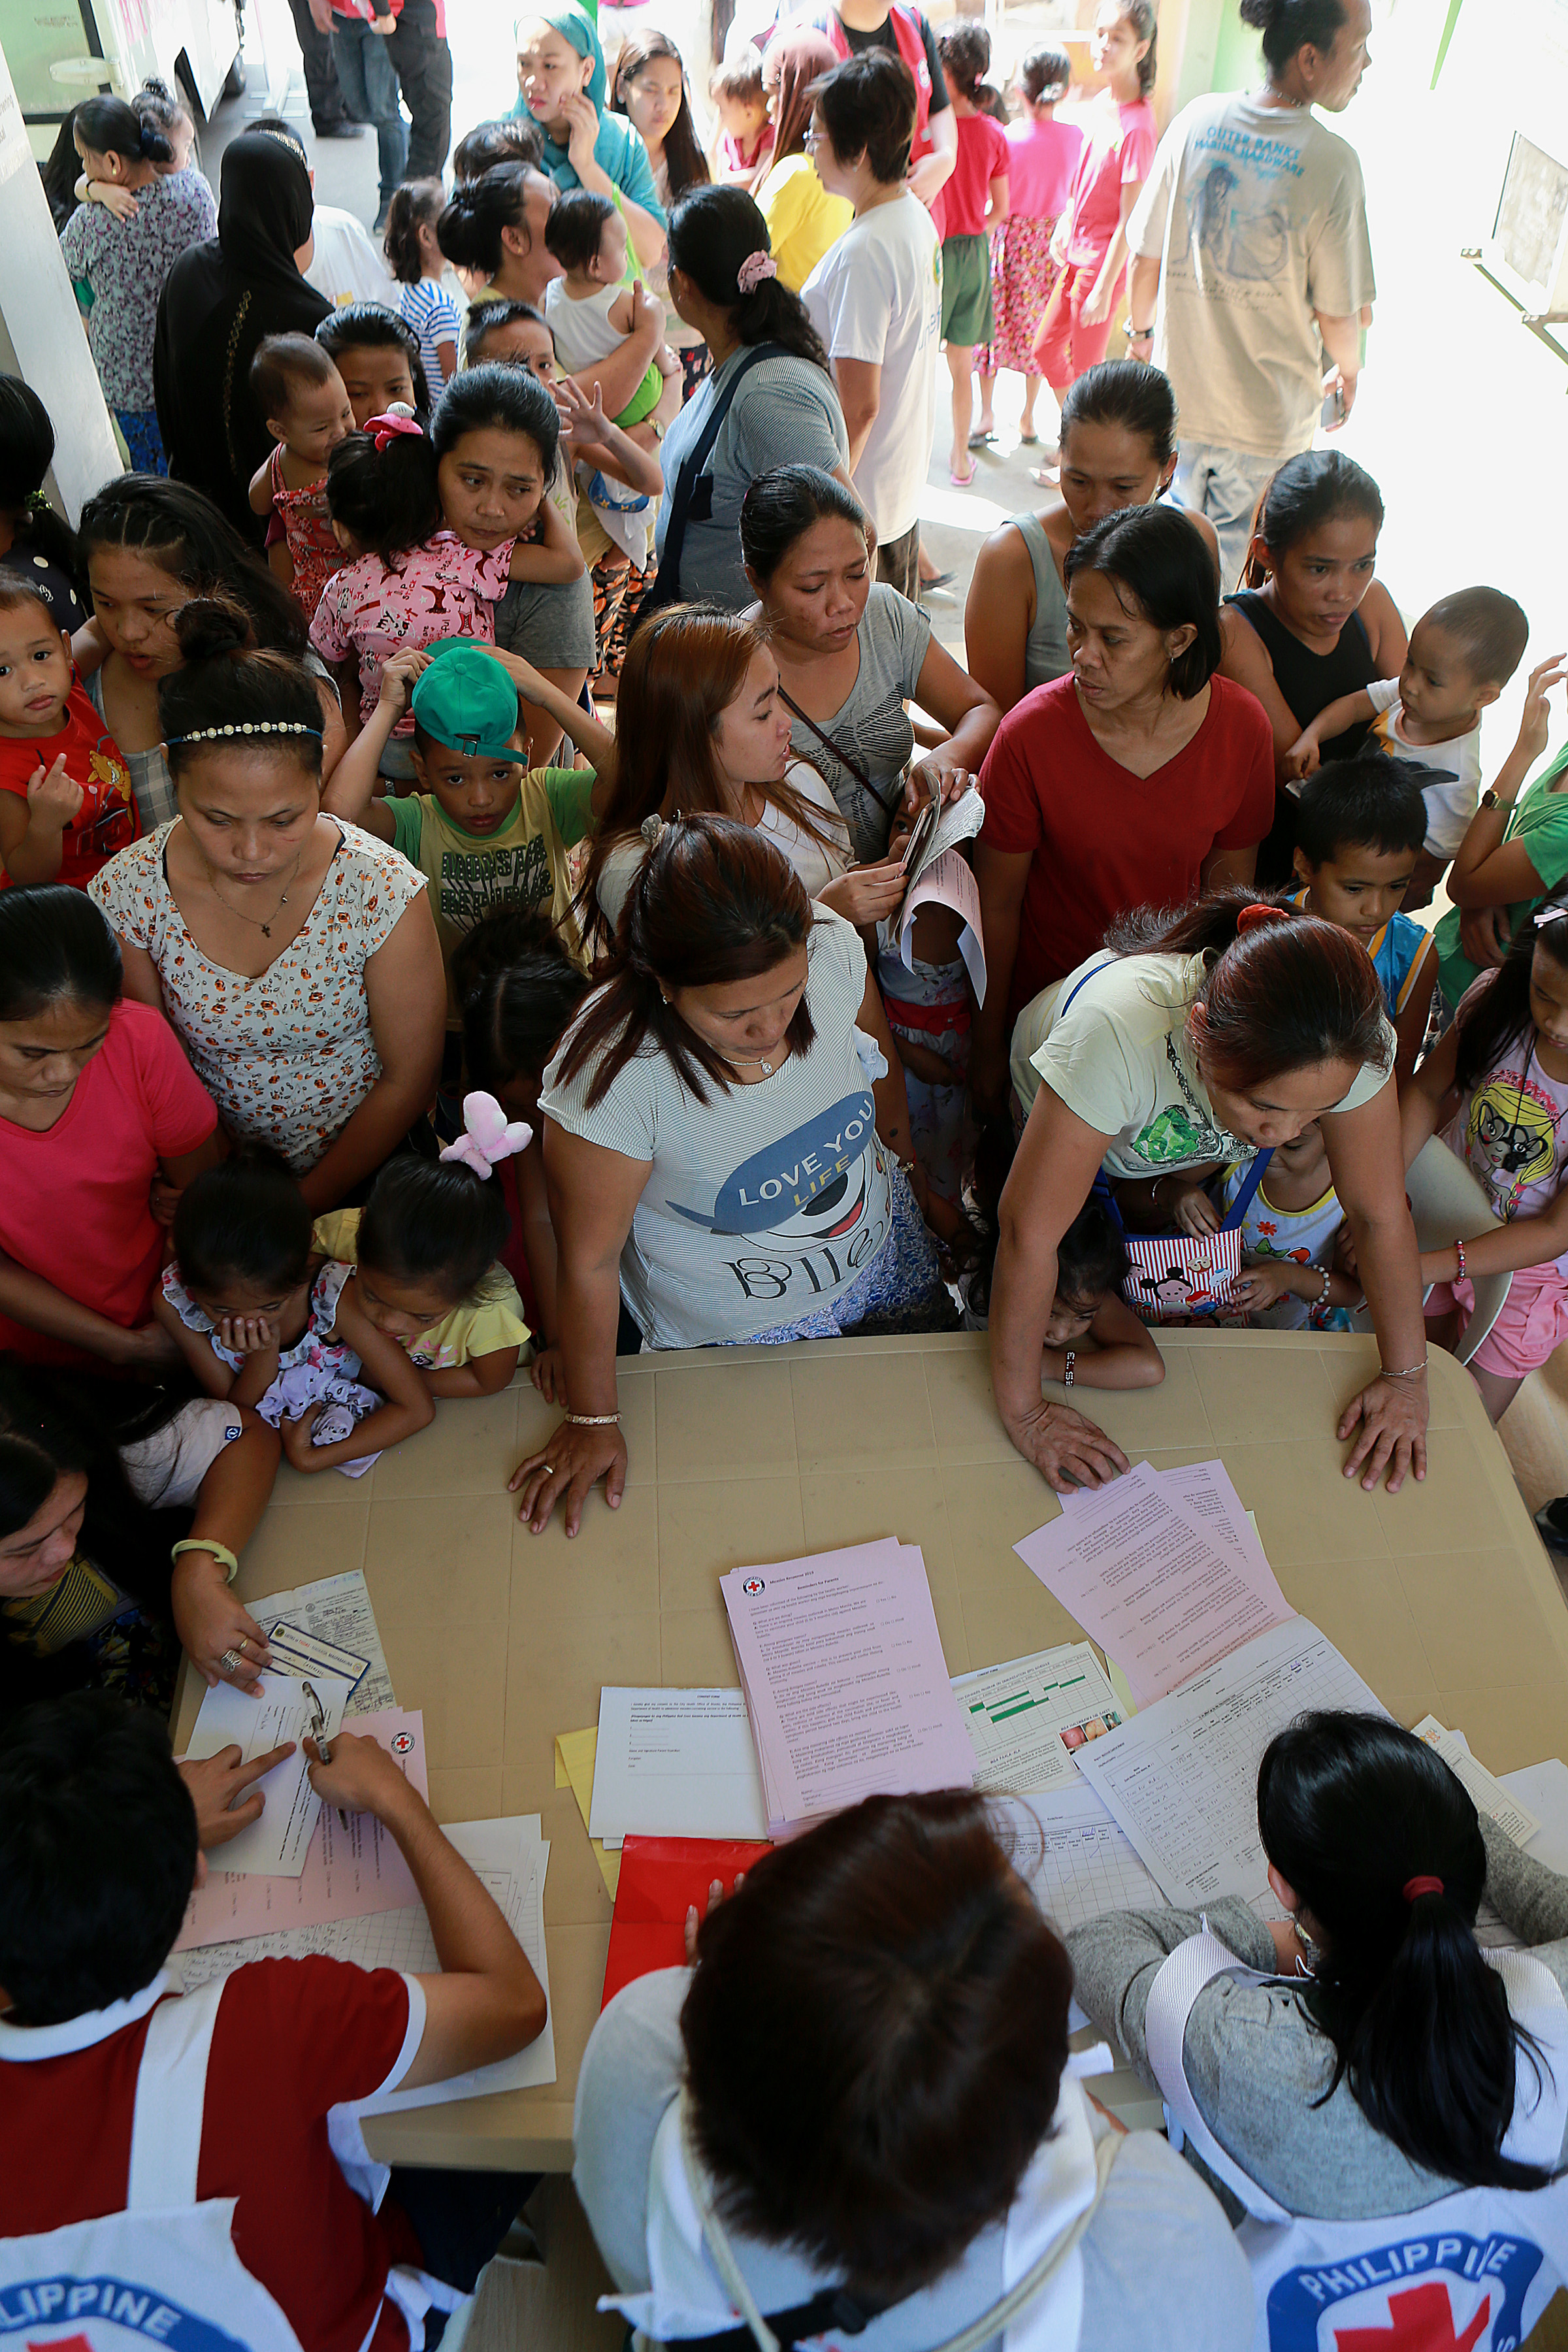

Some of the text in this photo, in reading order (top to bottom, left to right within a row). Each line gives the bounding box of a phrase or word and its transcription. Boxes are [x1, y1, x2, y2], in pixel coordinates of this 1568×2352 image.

[1195, 140, 1305, 177] MARINE HARDWARE
[1207, 127, 1301, 161] OUTER BANKS
[376, 611, 395, 629] my
[388, 607, 418, 646] heart
[442, 834, 547, 882] MONSTER
[739, 1099, 873, 1206] LOVE YOU
[793, 1154, 851, 1207] LIFE
